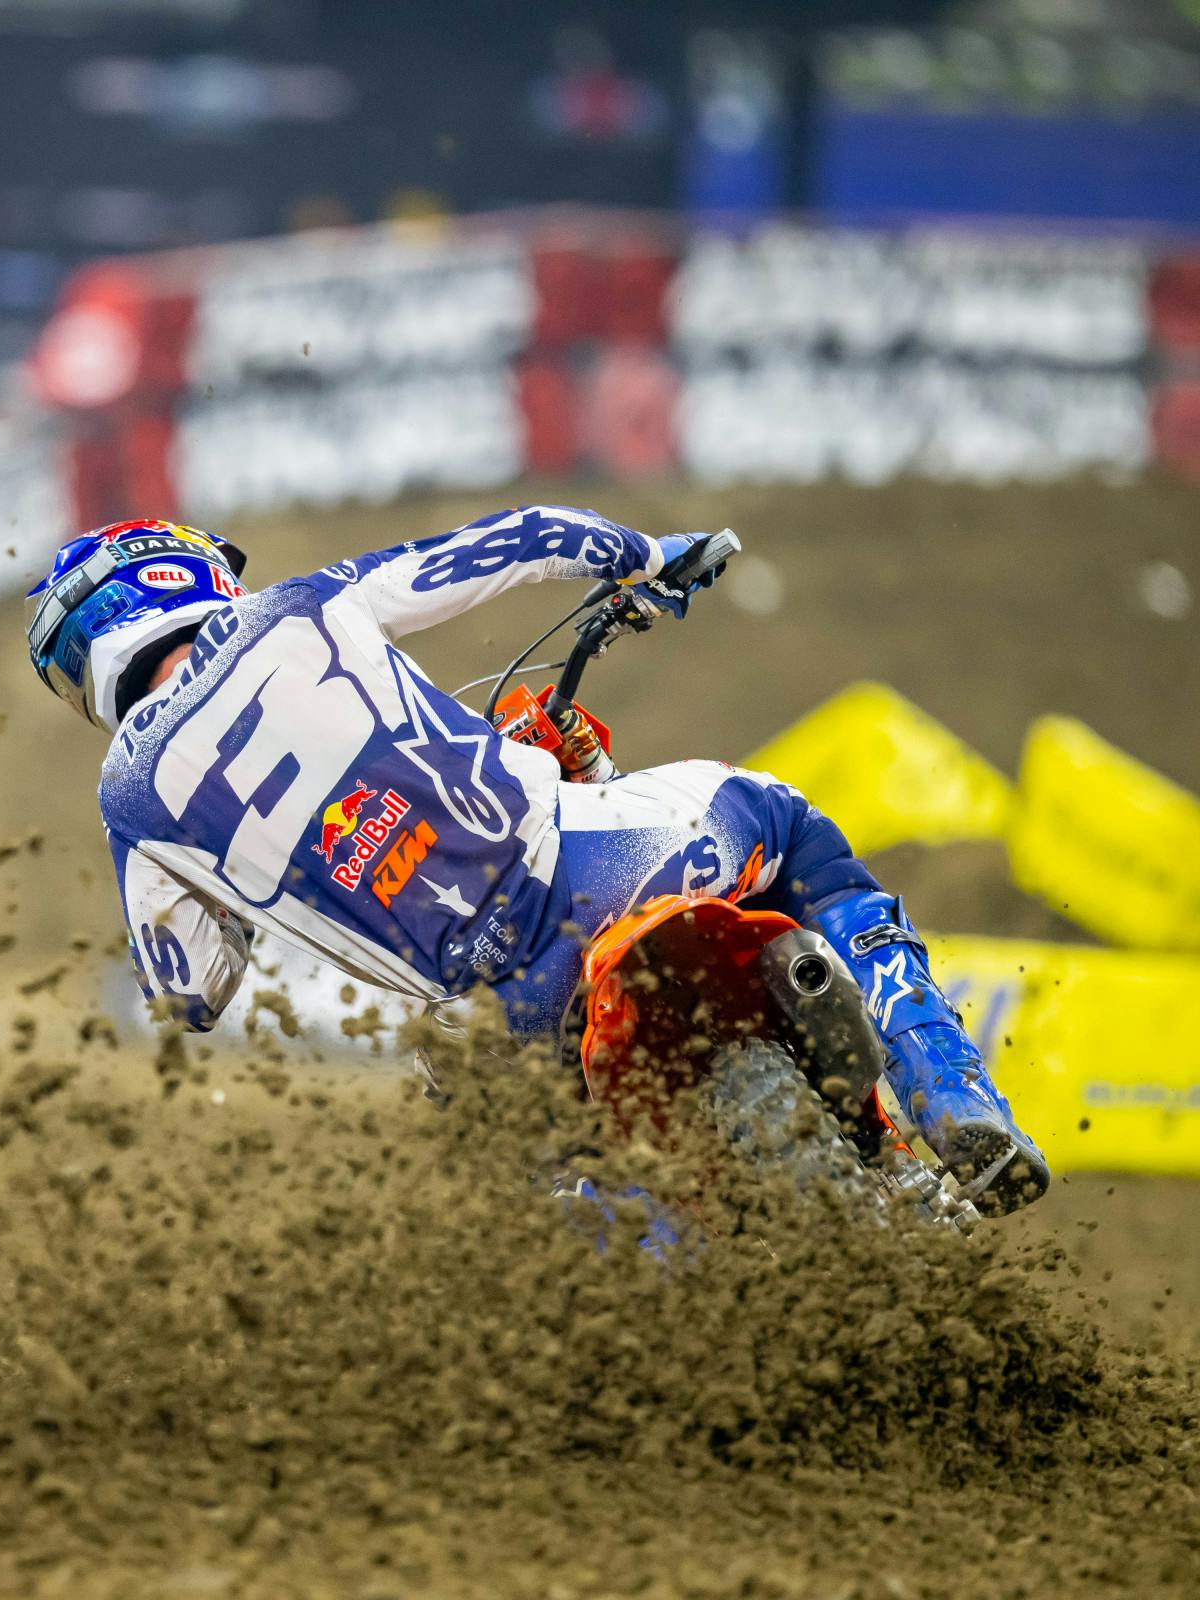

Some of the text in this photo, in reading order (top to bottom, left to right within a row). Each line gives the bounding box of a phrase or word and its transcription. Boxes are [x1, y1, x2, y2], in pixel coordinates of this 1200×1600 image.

[147, 571, 187, 582] BELL
[119, 605, 240, 759] TOAC
[153, 614, 378, 904] 3
[331, 788, 412, 892] Red Bull
[371, 819, 439, 911] KTM
[487, 916, 514, 945] TECH
